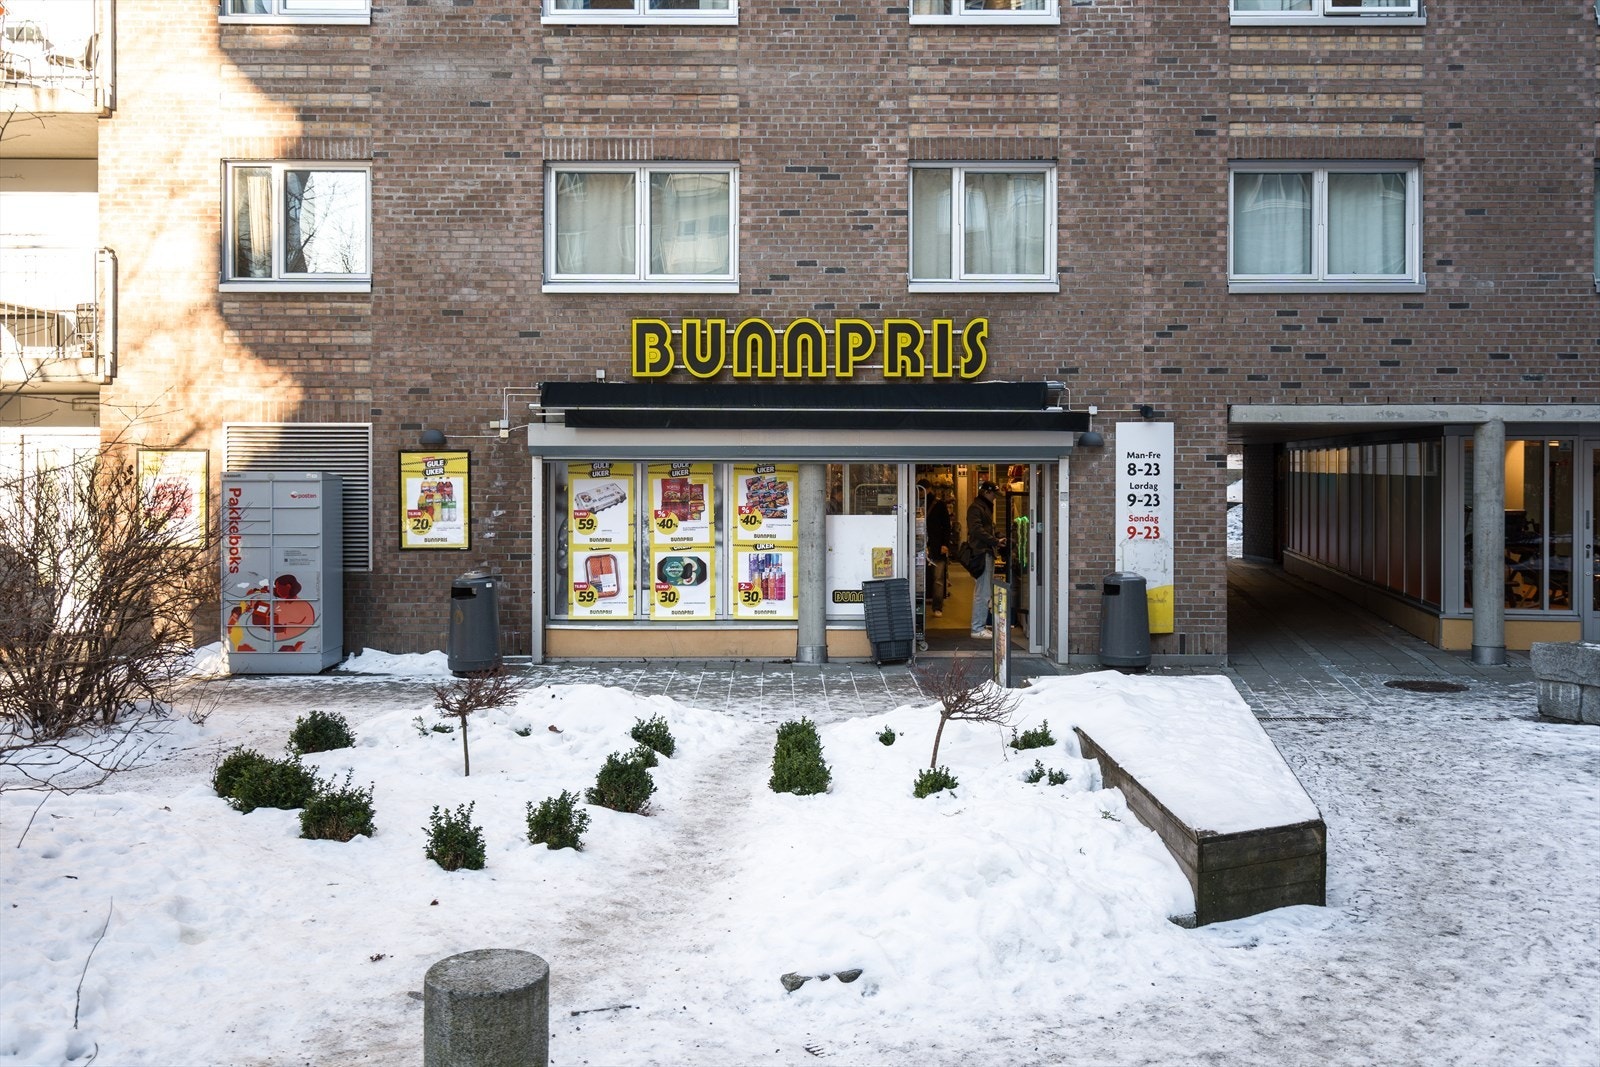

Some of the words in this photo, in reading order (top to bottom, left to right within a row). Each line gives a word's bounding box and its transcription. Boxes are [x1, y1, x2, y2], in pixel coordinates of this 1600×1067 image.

[632, 318, 989, 378] BUNNPRIS
[1127, 462, 1160, 476] 8-23
[1130, 482, 1158, 492] Lørdag
[1127, 494, 1160, 506] 9-23
[1128, 514, 1159, 524] Søndag
[229, 488, 242, 574] Pakkeboks
[1127, 526, 1160, 539] 9-23
